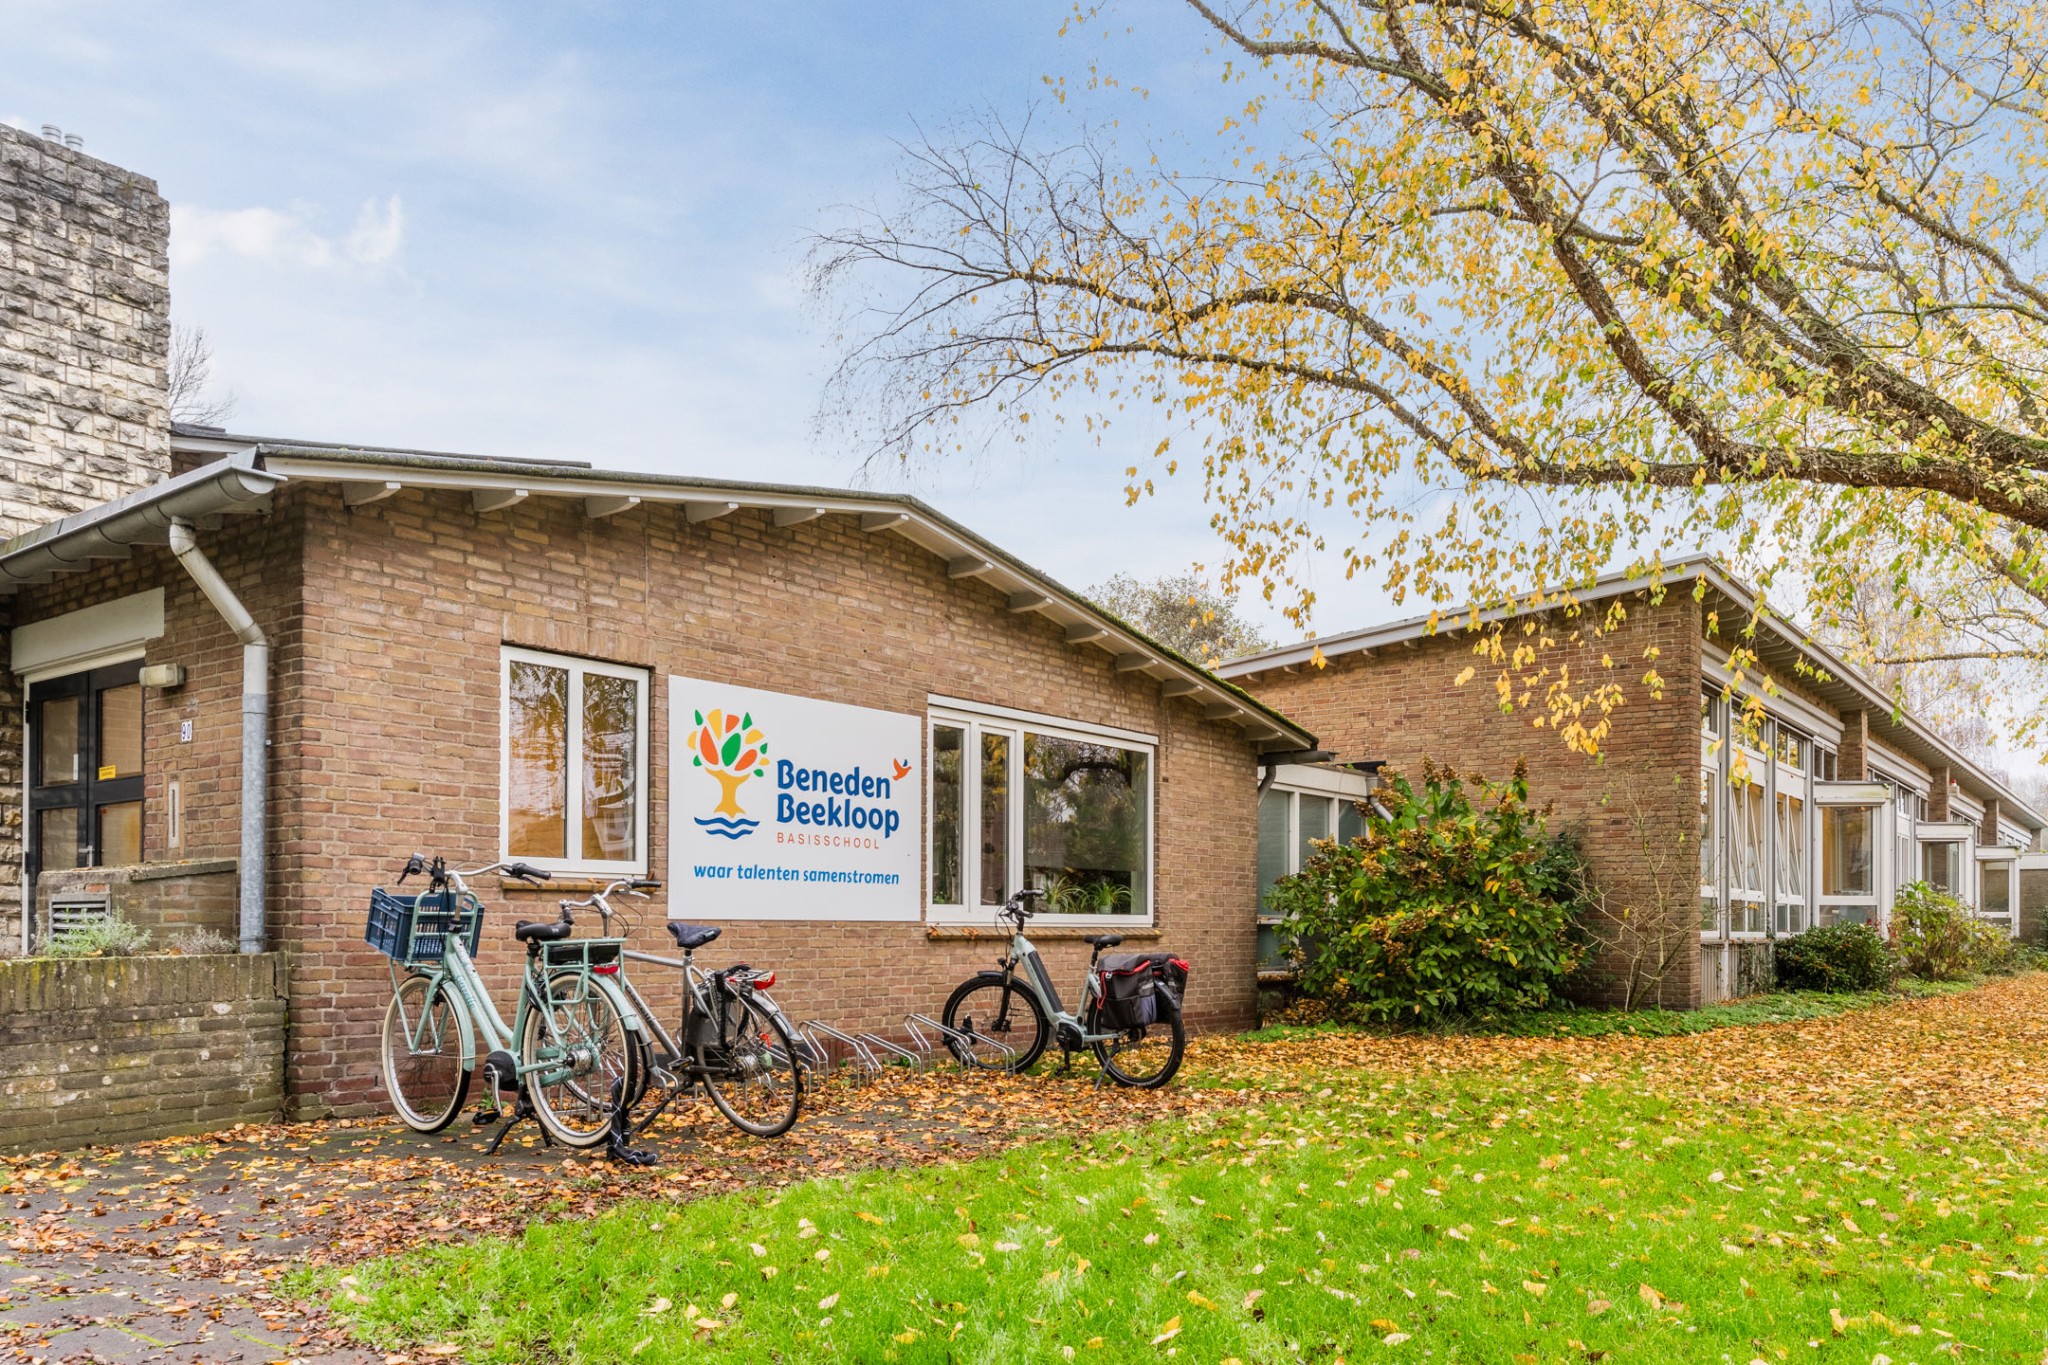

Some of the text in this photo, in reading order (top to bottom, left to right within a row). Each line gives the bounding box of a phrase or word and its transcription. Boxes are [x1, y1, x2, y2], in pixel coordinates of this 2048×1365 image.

[182, 723, 192, 740] 90
[777, 759, 890, 799] Beneden
[777, 793, 899, 838] Beekloop
[777, 832, 879, 849] BASISSCHOOL
[694, 864, 899, 884] waar talenten samenstromen
